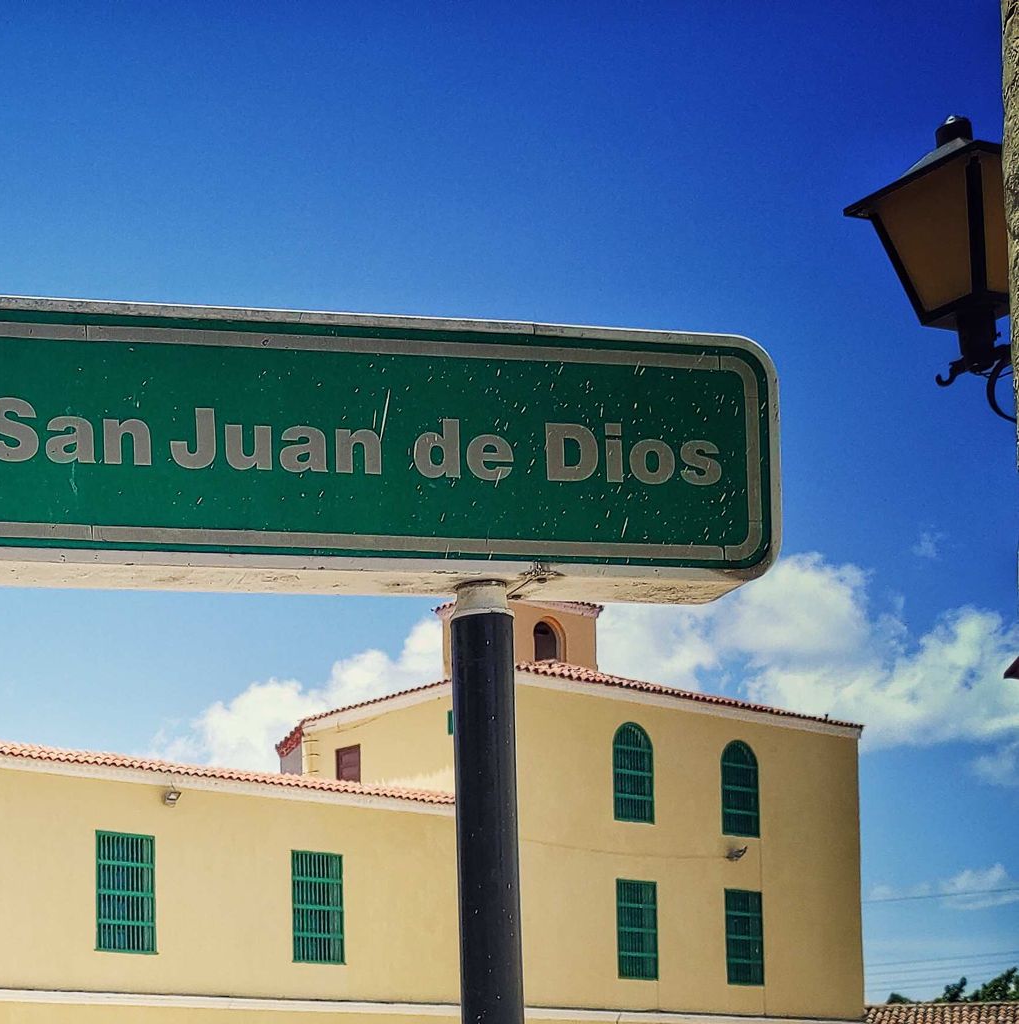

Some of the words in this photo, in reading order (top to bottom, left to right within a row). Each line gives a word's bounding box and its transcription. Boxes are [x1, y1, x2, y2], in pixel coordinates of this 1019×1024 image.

[169, 407, 383, 475] Juan
[413, 418, 514, 480] de
[543, 422, 723, 486] Dios
